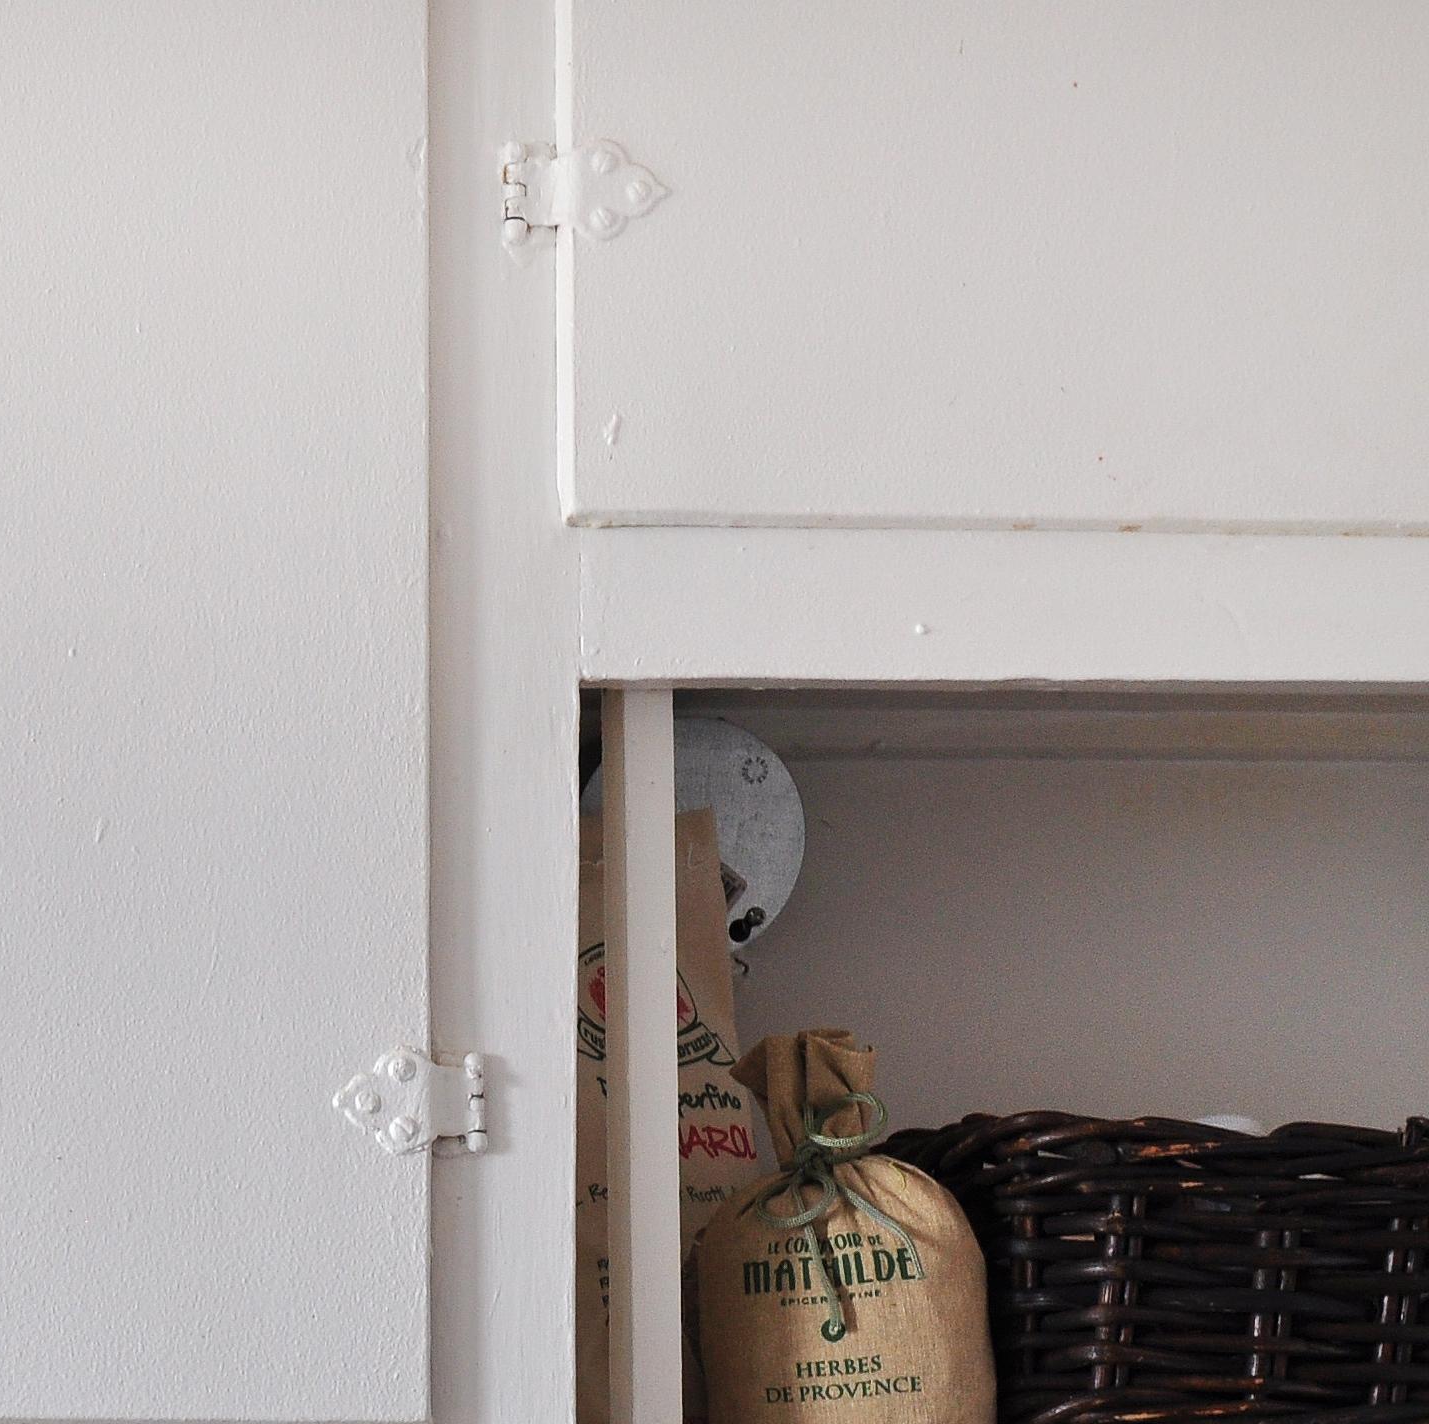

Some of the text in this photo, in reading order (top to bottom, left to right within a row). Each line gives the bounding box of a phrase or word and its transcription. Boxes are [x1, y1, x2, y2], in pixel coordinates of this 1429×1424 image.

[767, 1234, 883, 1255] LE DE
[743, 1247, 916, 1295] MATHILDE
[849, 1289, 882, 1300] FINE
[796, 1354, 882, 1378] HERBES
[766, 1375, 922, 1403] DE PROVENCE
